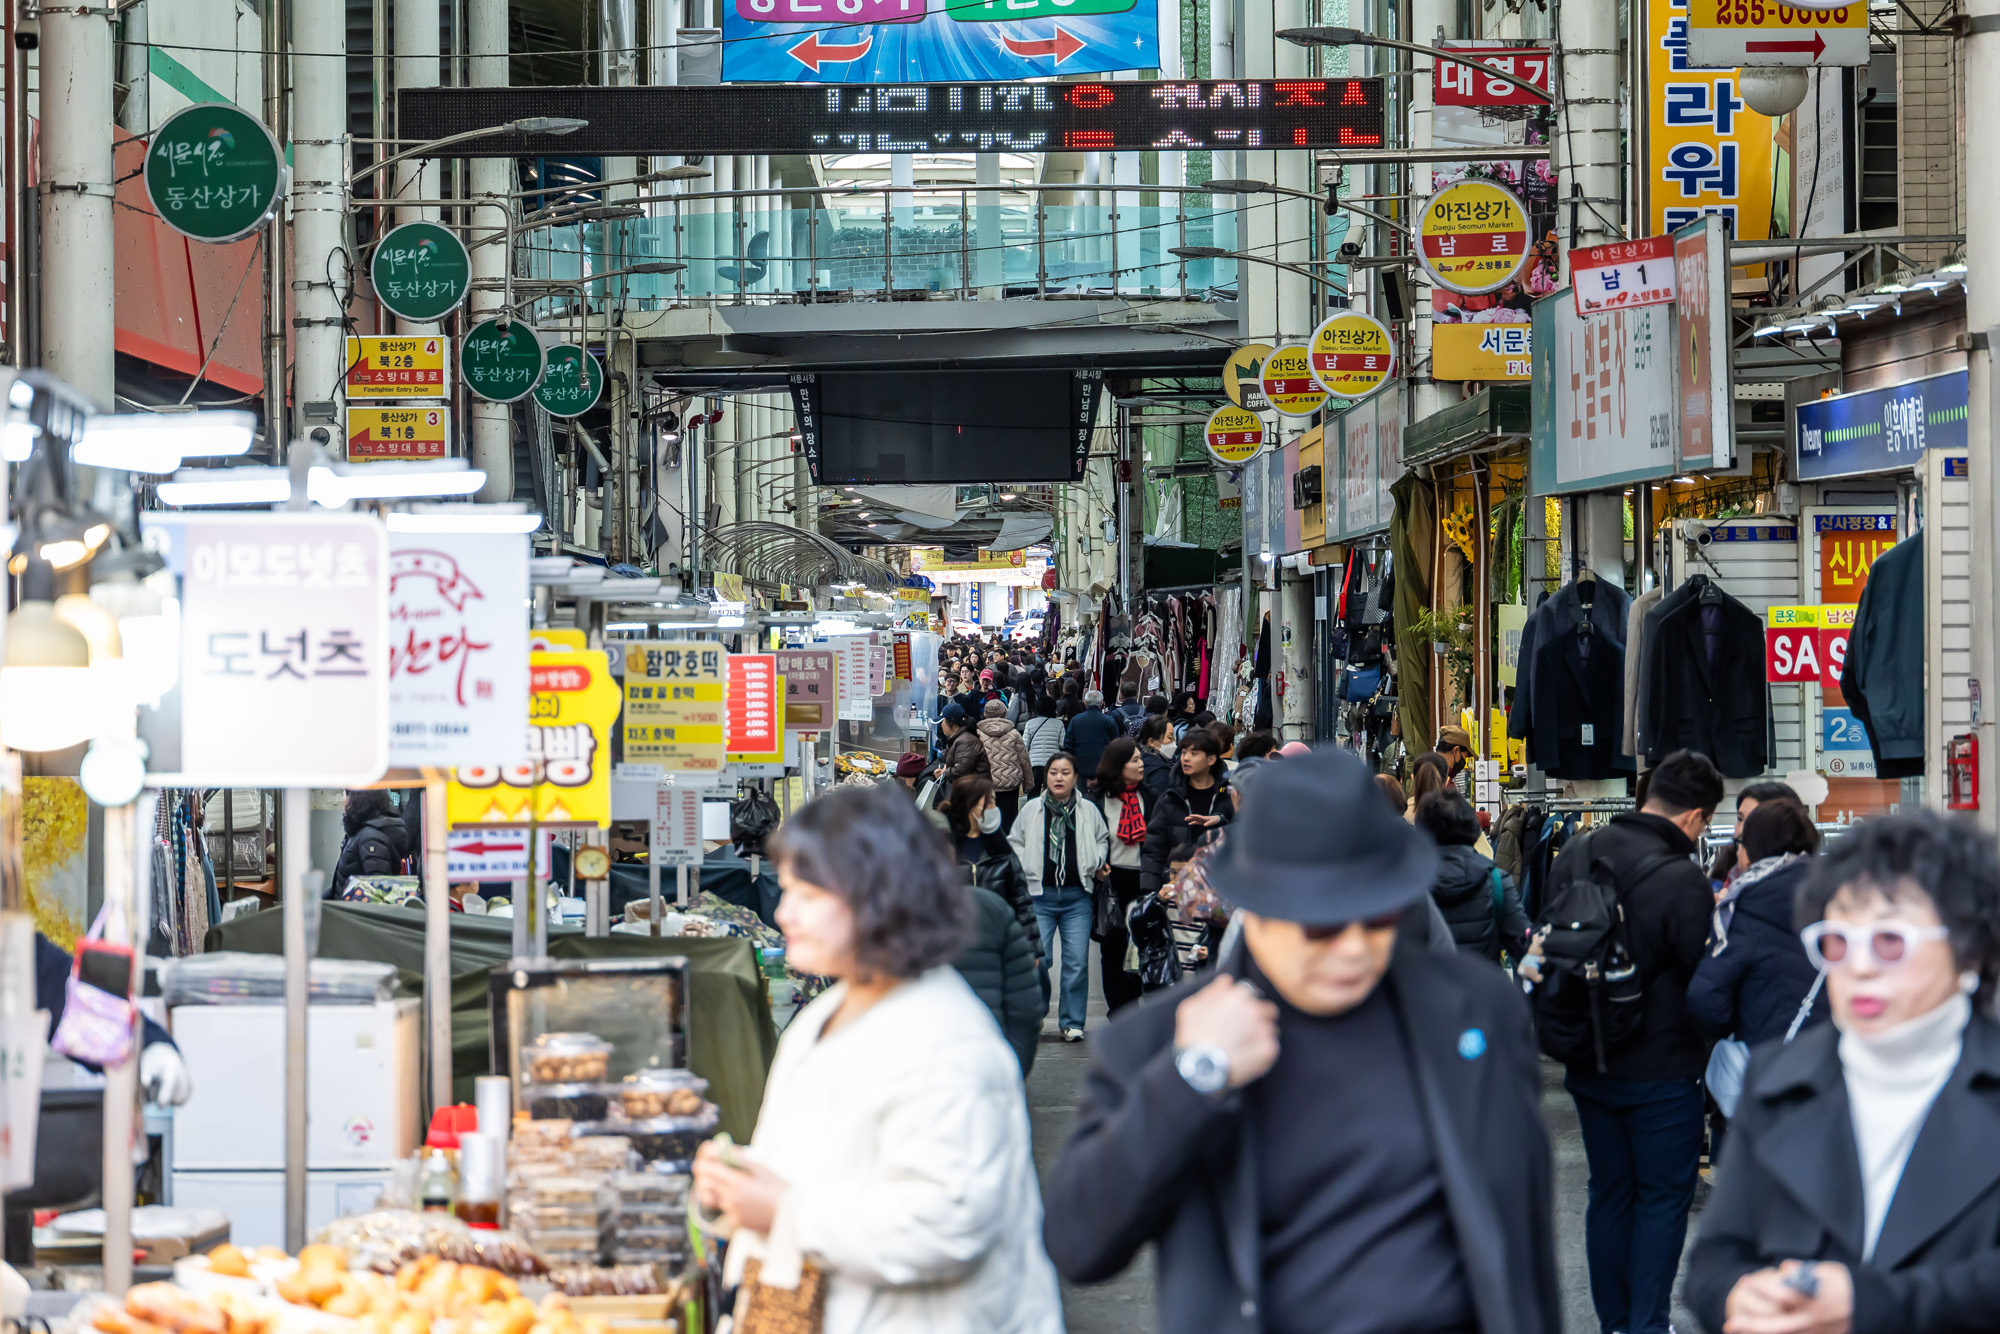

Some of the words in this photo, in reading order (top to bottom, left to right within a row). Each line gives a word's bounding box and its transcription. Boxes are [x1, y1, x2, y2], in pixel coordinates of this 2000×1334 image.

[156, 140, 226, 178] 서문시장
[164, 184, 262, 211] 동산상가
[1434, 200, 1511, 221] 아진상가
[1432, 223, 1456, 232] Daegu
[1458, 222, 1486, 230] Seomun
[1488, 221, 1514, 229] Market
[1591, 242, 1655, 261] 아진상가
[381, 247, 431, 275] 서문시장
[1476, 260, 1511, 271] 소방통로
[1601, 269, 1621, 291] 남
[1637, 264, 1647, 285] 1
[386, 280, 457, 299] 동산상가
[1630, 287, 1673, 303] 소방통로
[1323, 329, 1381, 345] 아진상가
[379, 341, 416, 352] 동산상가
[426, 340, 436, 354] 4
[379, 355, 390, 368] 북
[394, 354, 414, 368] 2층
[472, 367, 531, 383] 동산상가
[544, 363, 574, 383] 문시장
[790, 374, 815, 383] 서문시장
[1075, 370, 1102, 379] 서문시장
[1351, 374, 1379, 382] 소방통로
[363, 386, 395, 394] Firefighter
[396, 386, 412, 394] Entry
[541, 386, 593, 400] 동산상가
[1080, 384, 1091, 423] 만남의
[1298, 395, 1321, 403] 소방통로
[800, 388, 813, 427] 만남의
[380, 412, 417, 423] 동산상가
[428, 412, 438, 426] 3
[1214, 414, 1255, 427] 아진상가
[380, 426, 391, 439] 북
[396, 425, 415, 439] 1층
[806, 432, 817, 458] 장소
[1076, 428, 1088, 454] 장소
[811, 462, 818, 477] 1
[1076, 458, 1083, 472] 1
[899, 591, 920, 599] 화장품
[203, 627, 368, 681] 도넛츠
[646, 650, 719, 678] 참맛호떡
[627, 728, 649, 740] 치즈
[653, 728, 676, 740] 호떡
[1830, 716, 1863, 742] 2층
